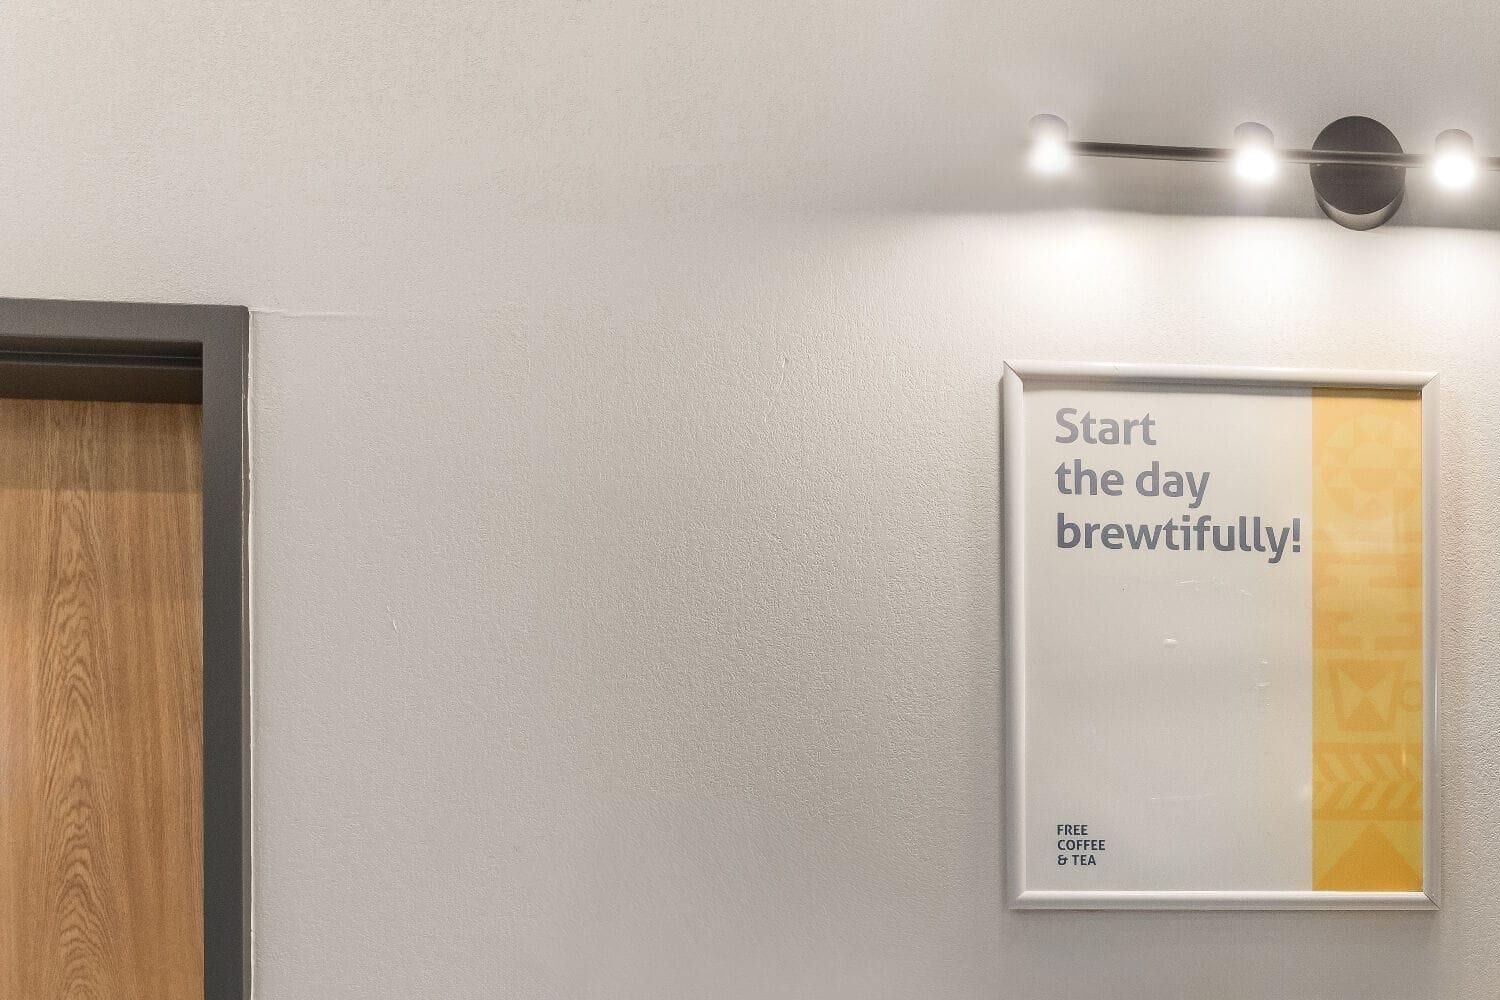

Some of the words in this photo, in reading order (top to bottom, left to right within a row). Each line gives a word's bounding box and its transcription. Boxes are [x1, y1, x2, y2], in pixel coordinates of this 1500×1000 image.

[1054, 407, 1157, 446] Start
[1054, 458, 1125, 497] the
[1135, 460, 1211, 509] day
[1056, 512, 1301, 564] brewtifully!
[1057, 824, 1088, 836] FREE
[1057, 839, 1106, 851] COFFEE
[1057, 854, 1069, 866] &
[1071, 854, 1097, 866] TEA
